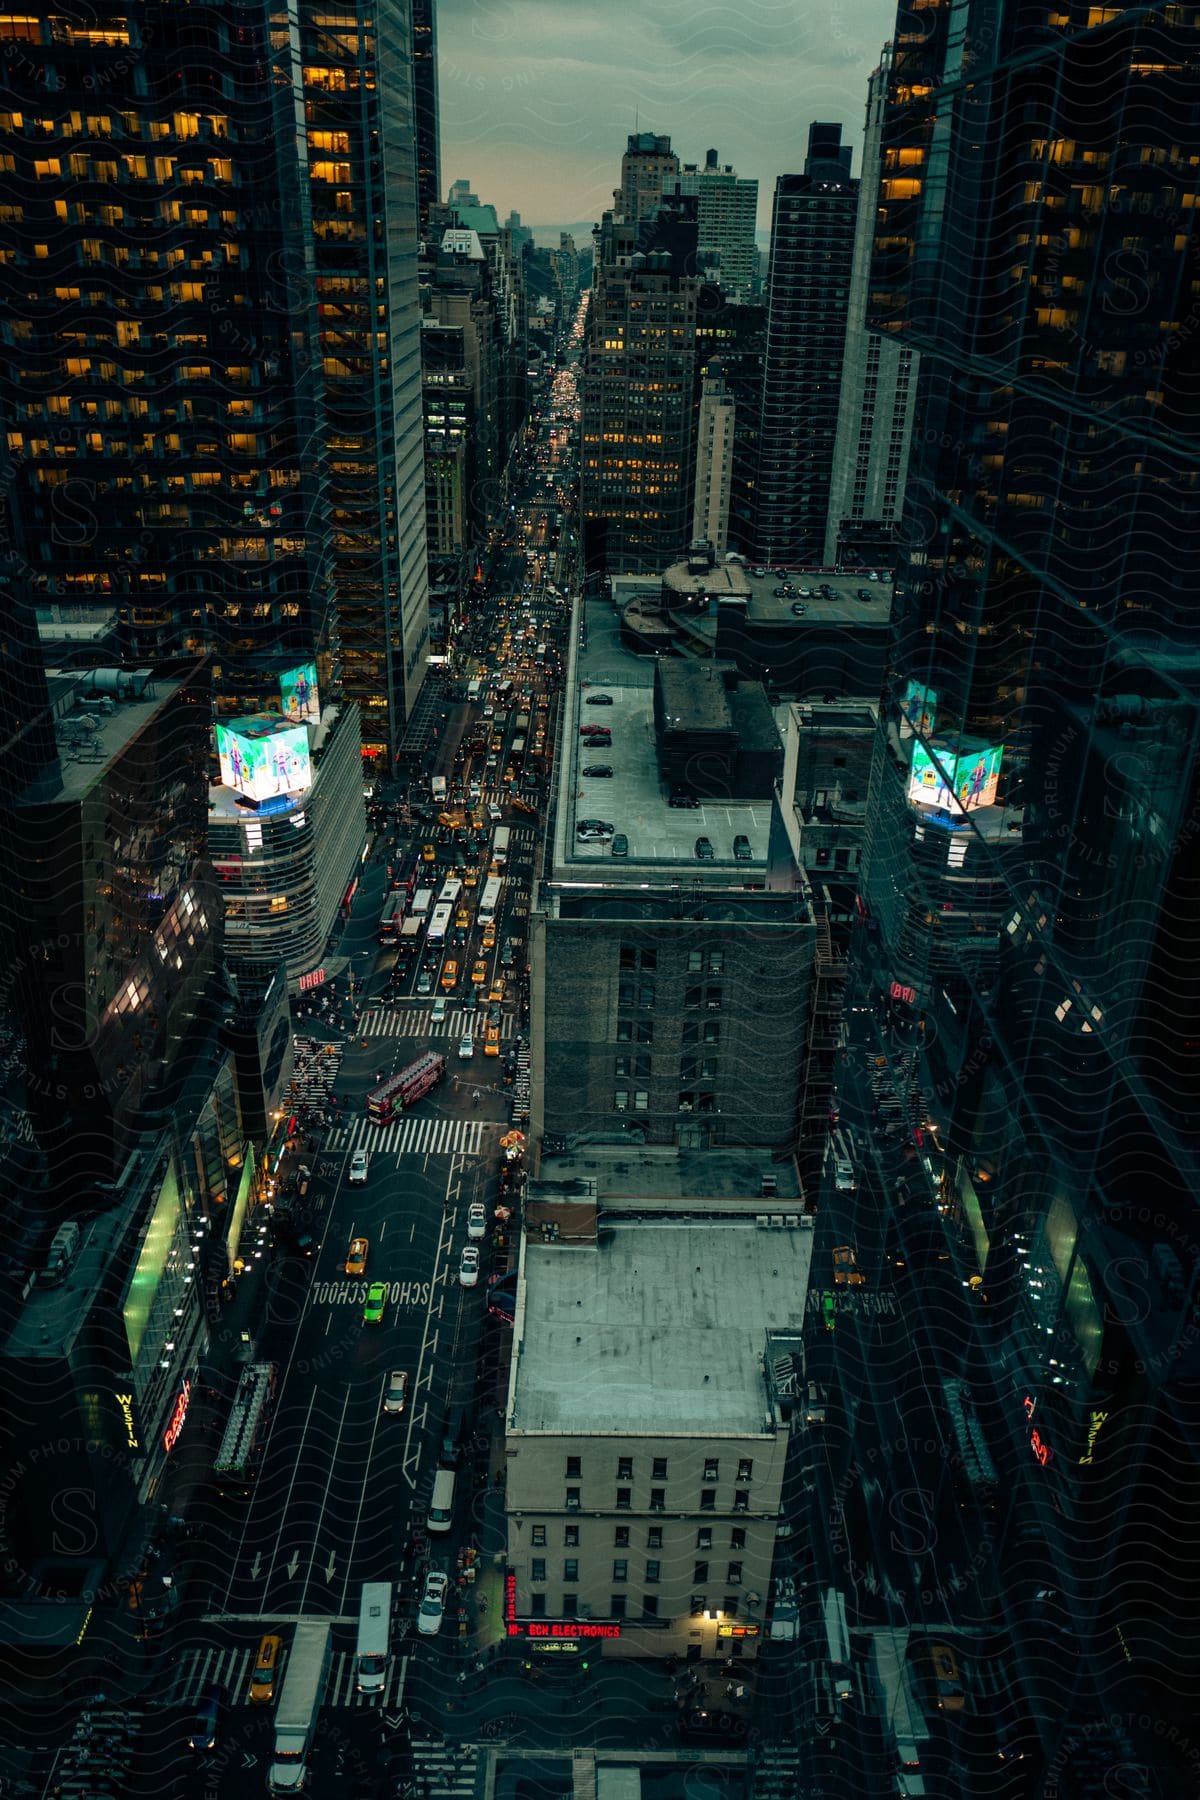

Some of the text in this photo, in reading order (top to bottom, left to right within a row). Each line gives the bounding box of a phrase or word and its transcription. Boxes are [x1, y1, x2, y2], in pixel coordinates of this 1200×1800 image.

[313, 1282, 368, 1305] SCHOOL
[115, 1394, 139, 1448] WESTIN
[552, 1624, 620, 1638] ELECTRONICS
